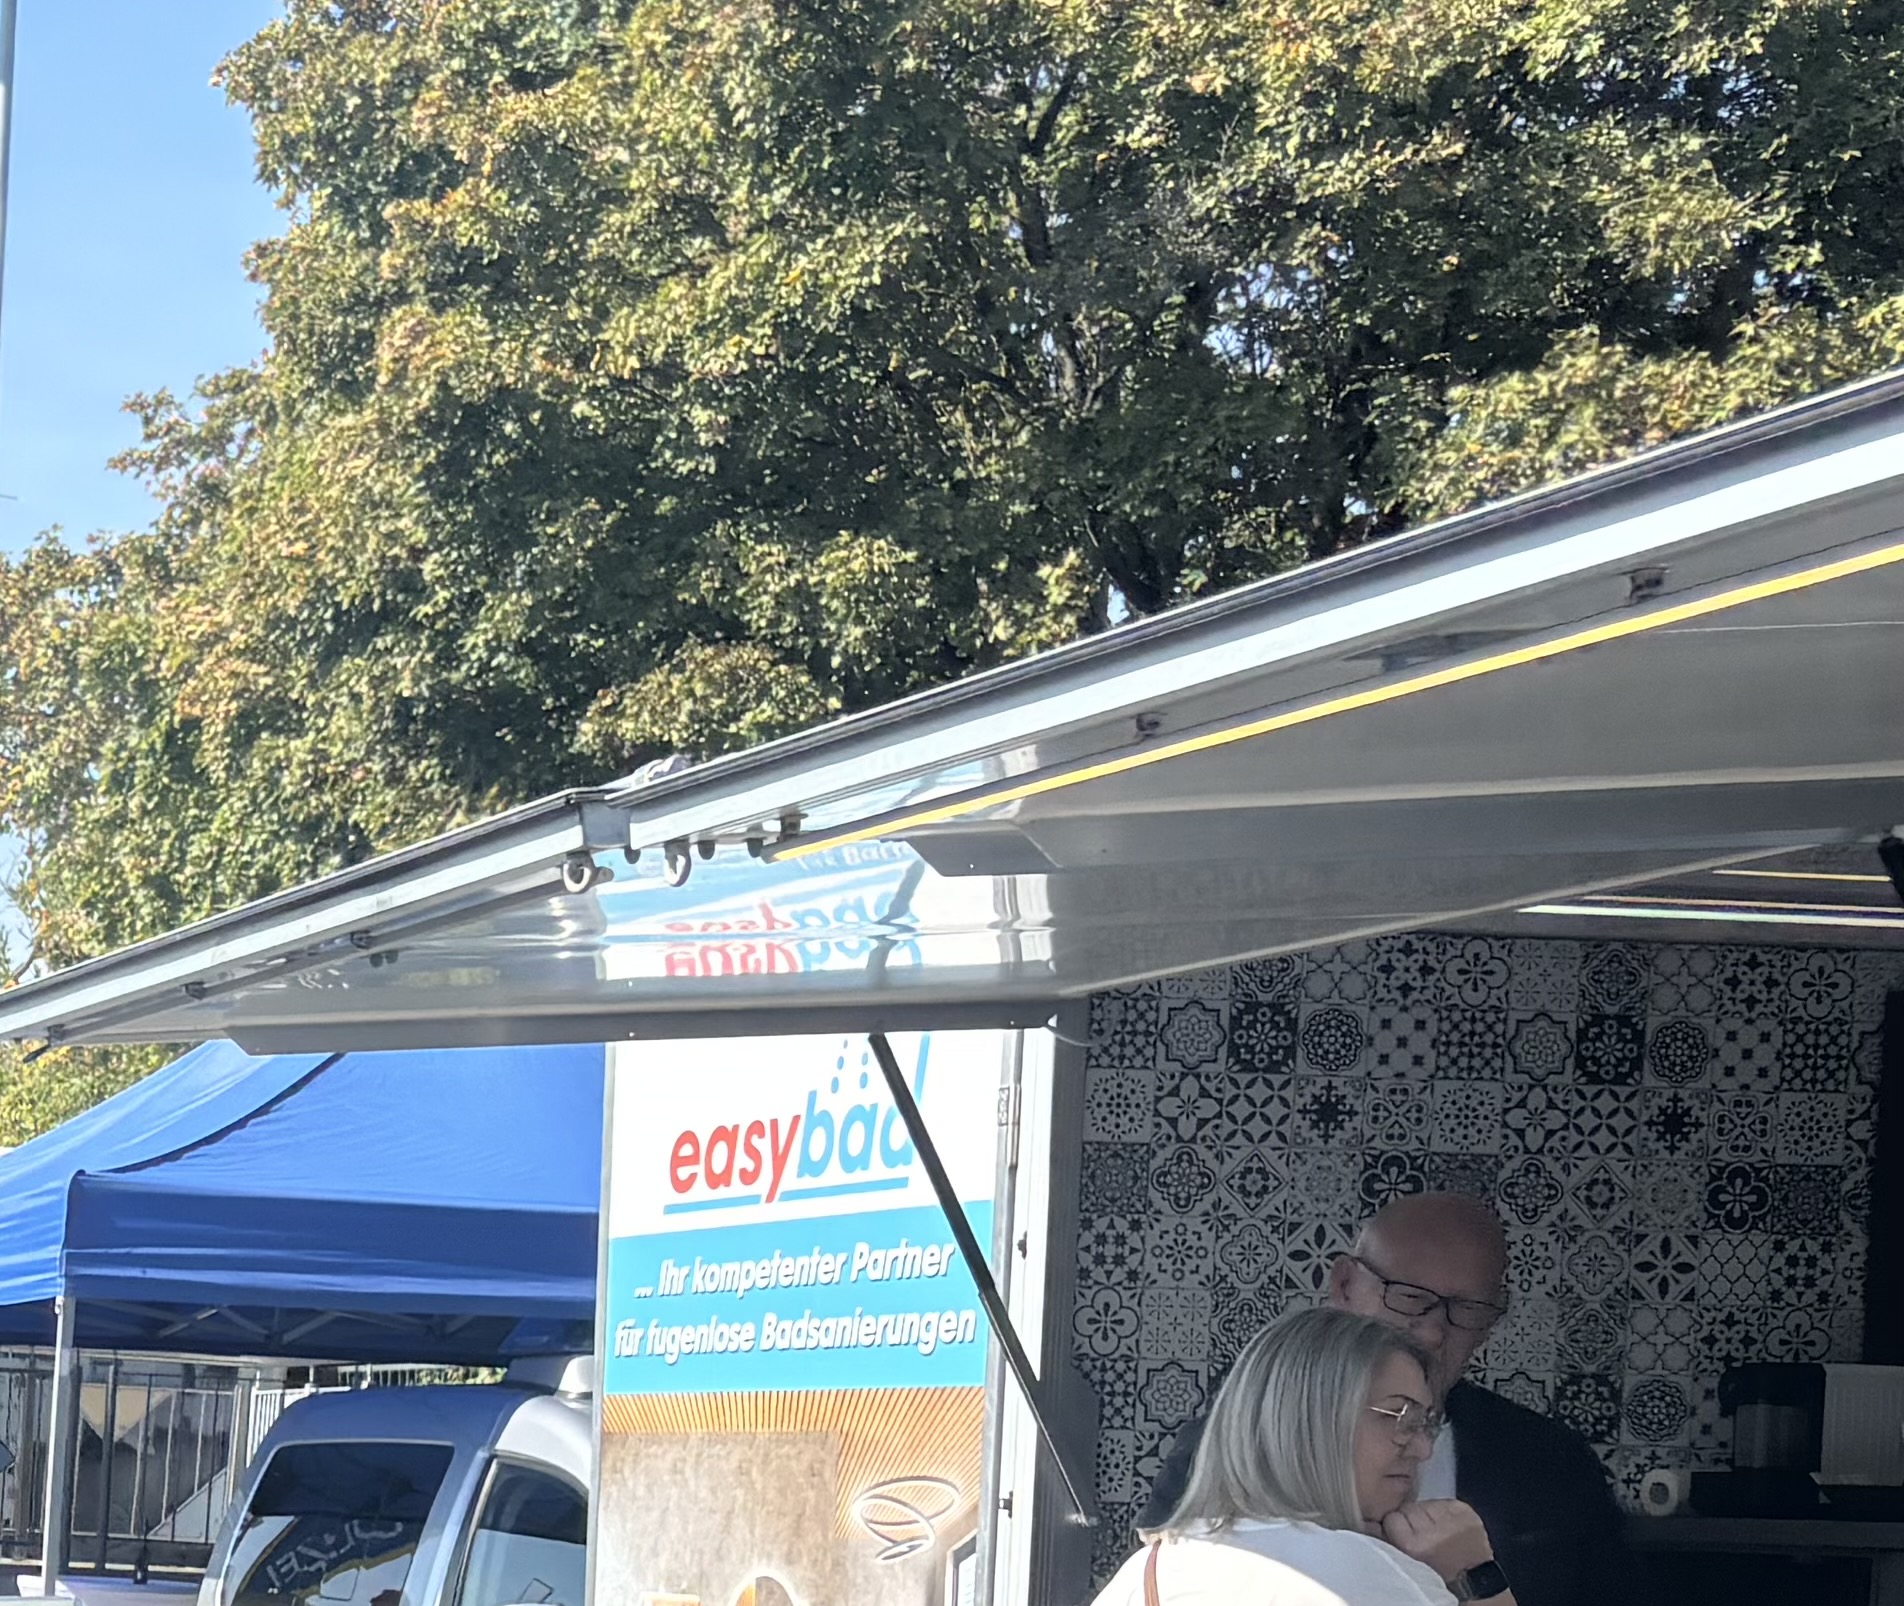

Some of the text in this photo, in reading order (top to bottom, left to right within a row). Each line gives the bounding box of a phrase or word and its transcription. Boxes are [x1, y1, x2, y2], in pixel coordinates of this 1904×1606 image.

[669, 1034, 930, 1204] easybad
[658, 1259, 690, 1297] Ihr
[692, 1246, 848, 1299] kompetenter
[849, 1238, 956, 1283] Partner
[614, 1307, 977, 1365] für fugenlose Badsanierungen
